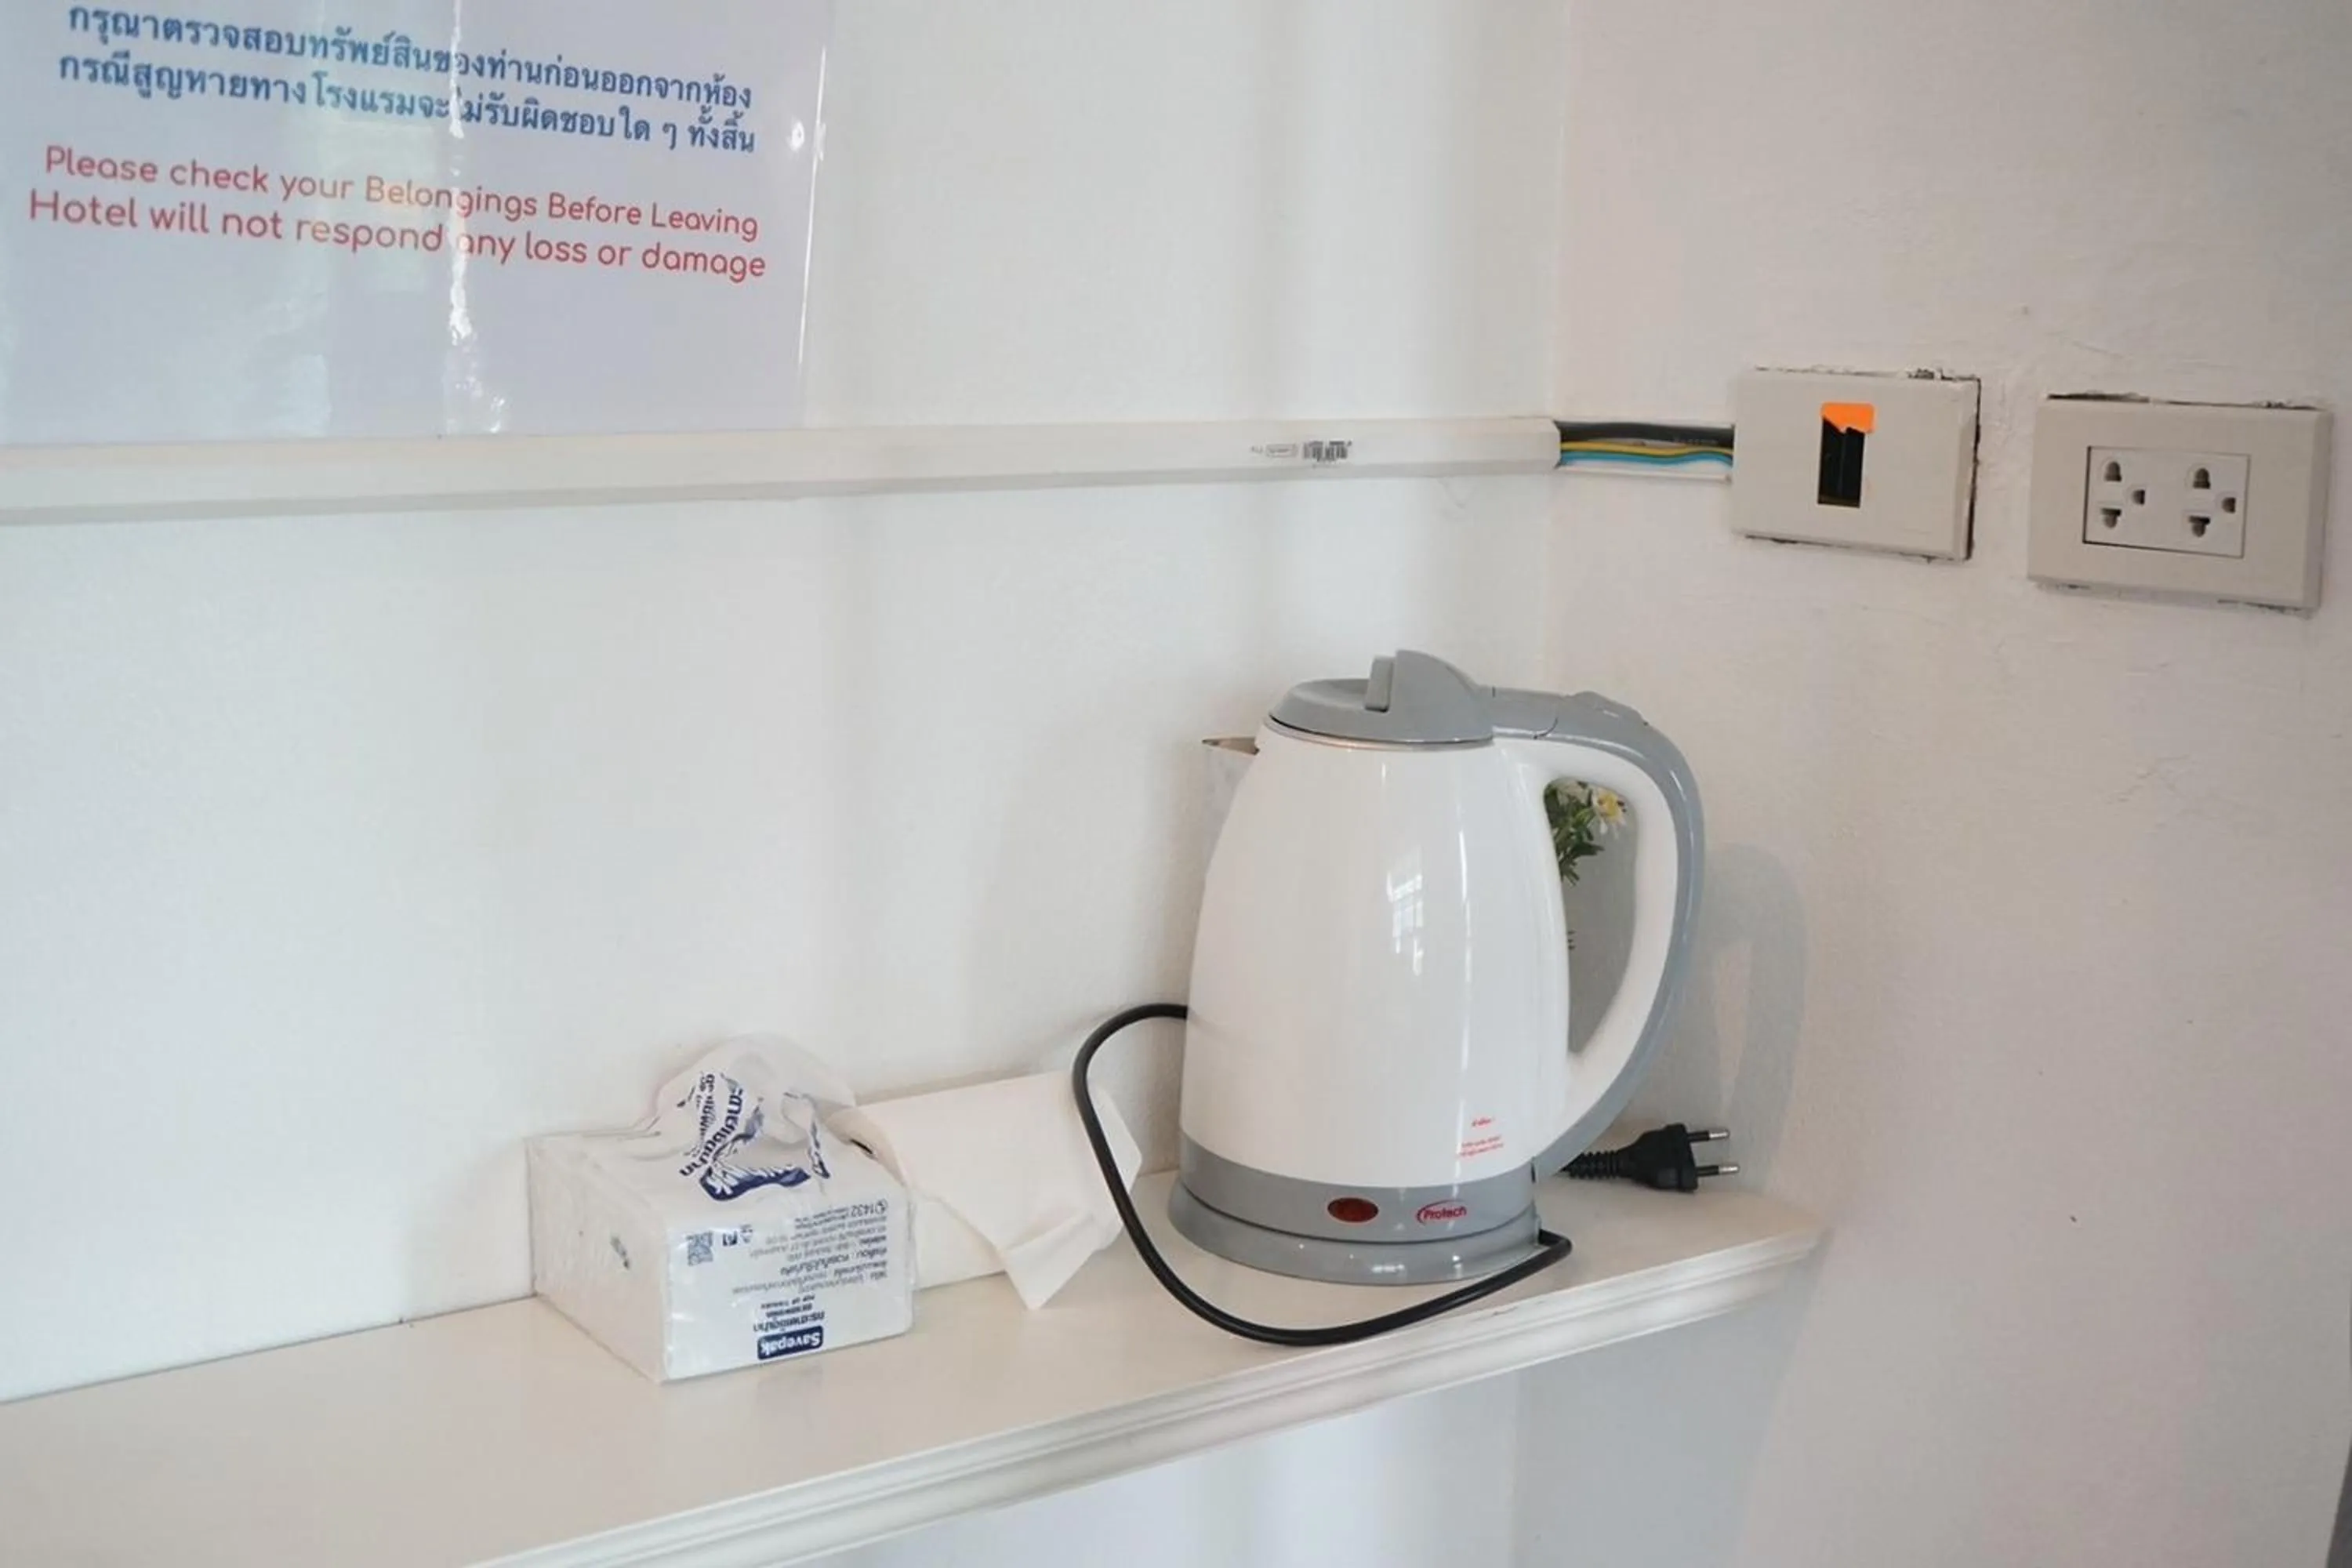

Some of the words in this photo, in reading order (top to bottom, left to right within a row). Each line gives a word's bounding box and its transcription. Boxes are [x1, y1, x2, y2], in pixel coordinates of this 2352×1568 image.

[69, 6, 751, 109] กรุณาตรวจสอบทรัพย์สินของท่านก่อนออกจากห้อง
[688, 105, 756, 153] ทั้งสิ้น
[45, 144, 158, 183] Please
[169, 159, 269, 194] check
[279, 175, 354, 201] your
[365, 175, 538, 223] Belongings
[548, 191, 642, 226] Before
[651, 201, 758, 243] Leaving
[29, 187, 139, 228] Hotel
[149, 201, 210, 234] will
[221, 210, 283, 240] not
[296, 219, 444, 255] respond
[457, 232, 517, 266] any
[524, 230, 588, 264] loss
[597, 244, 633, 267] or
[641, 241, 766, 285] damage
[1422, 1206, 1468, 1220] Protech
[760, 1331, 822, 1356] Savepak
